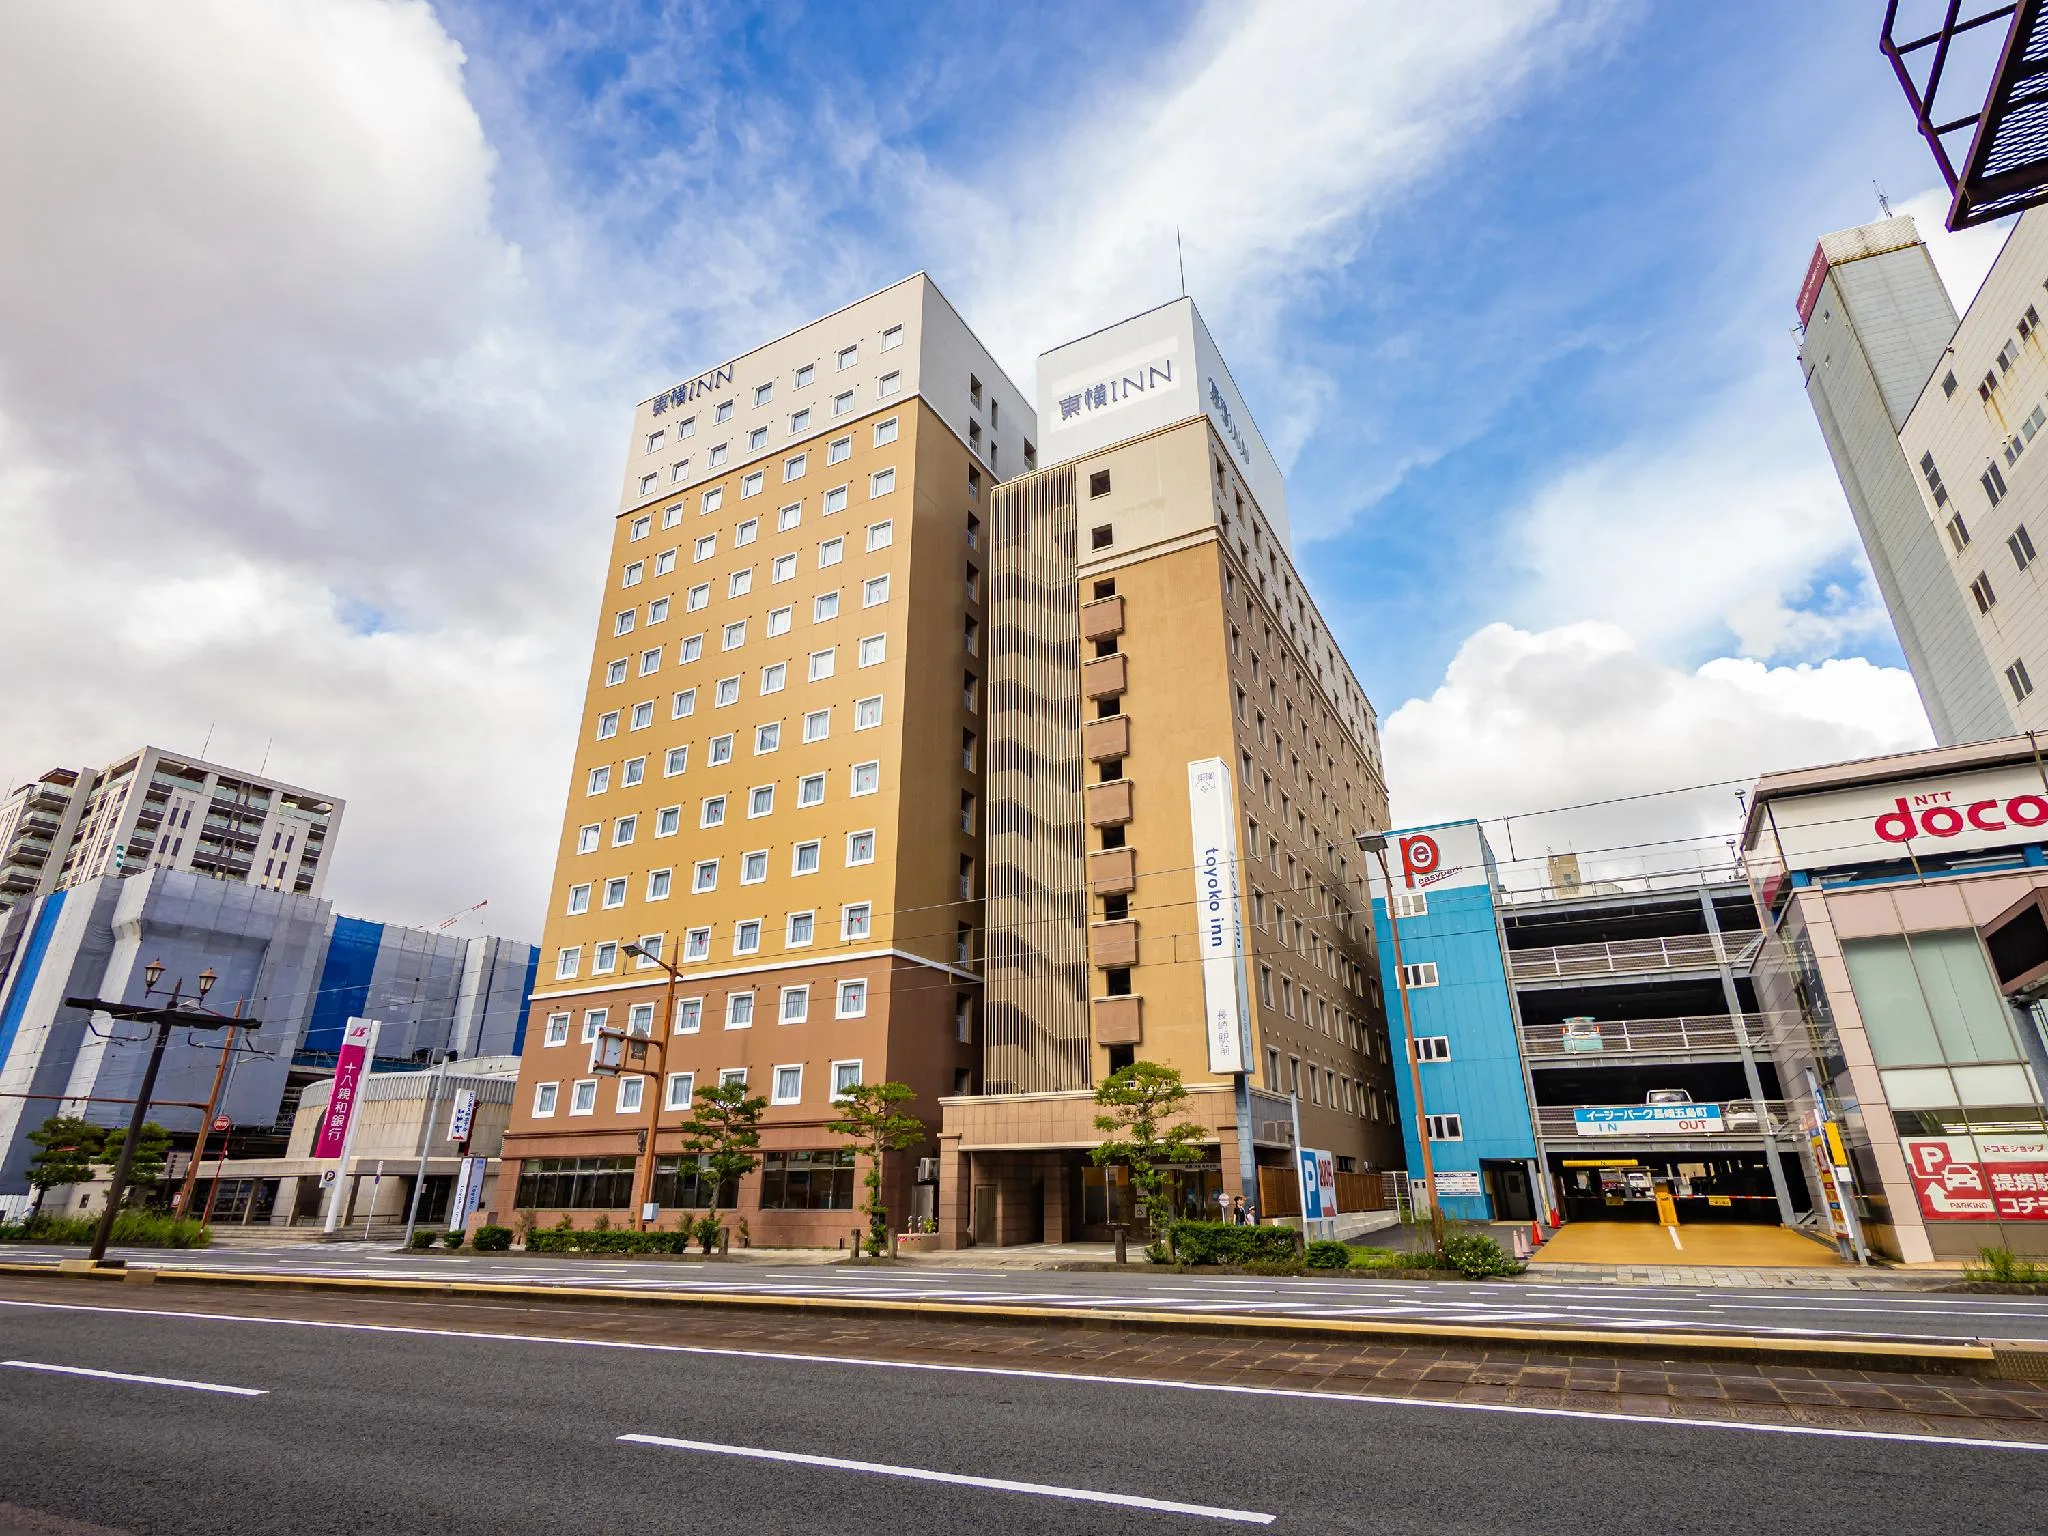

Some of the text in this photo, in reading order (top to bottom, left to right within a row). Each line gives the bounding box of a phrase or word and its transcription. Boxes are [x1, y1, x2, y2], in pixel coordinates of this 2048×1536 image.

[1058, 359, 1172, 421] 東横INN
[1913, 791, 1951, 806] NTT
[1874, 794, 2048, 843] doco
[1203, 847, 1225, 948] toyoko inn
[327, 1061, 357, 1141] 十八親和銀行
[1586, 1107, 1708, 1121] イージーパーク長崎五島町
[1598, 1122, 1618, 1132] IN
[1678, 1120, 1707, 1131] OUT
[1919, 1146, 1945, 1173] P
[1983, 1144, 2044, 1154] ドコモショップ
[1303, 1159, 1317, 1210] P
[1949, 1201, 1989, 1210] PARKING
